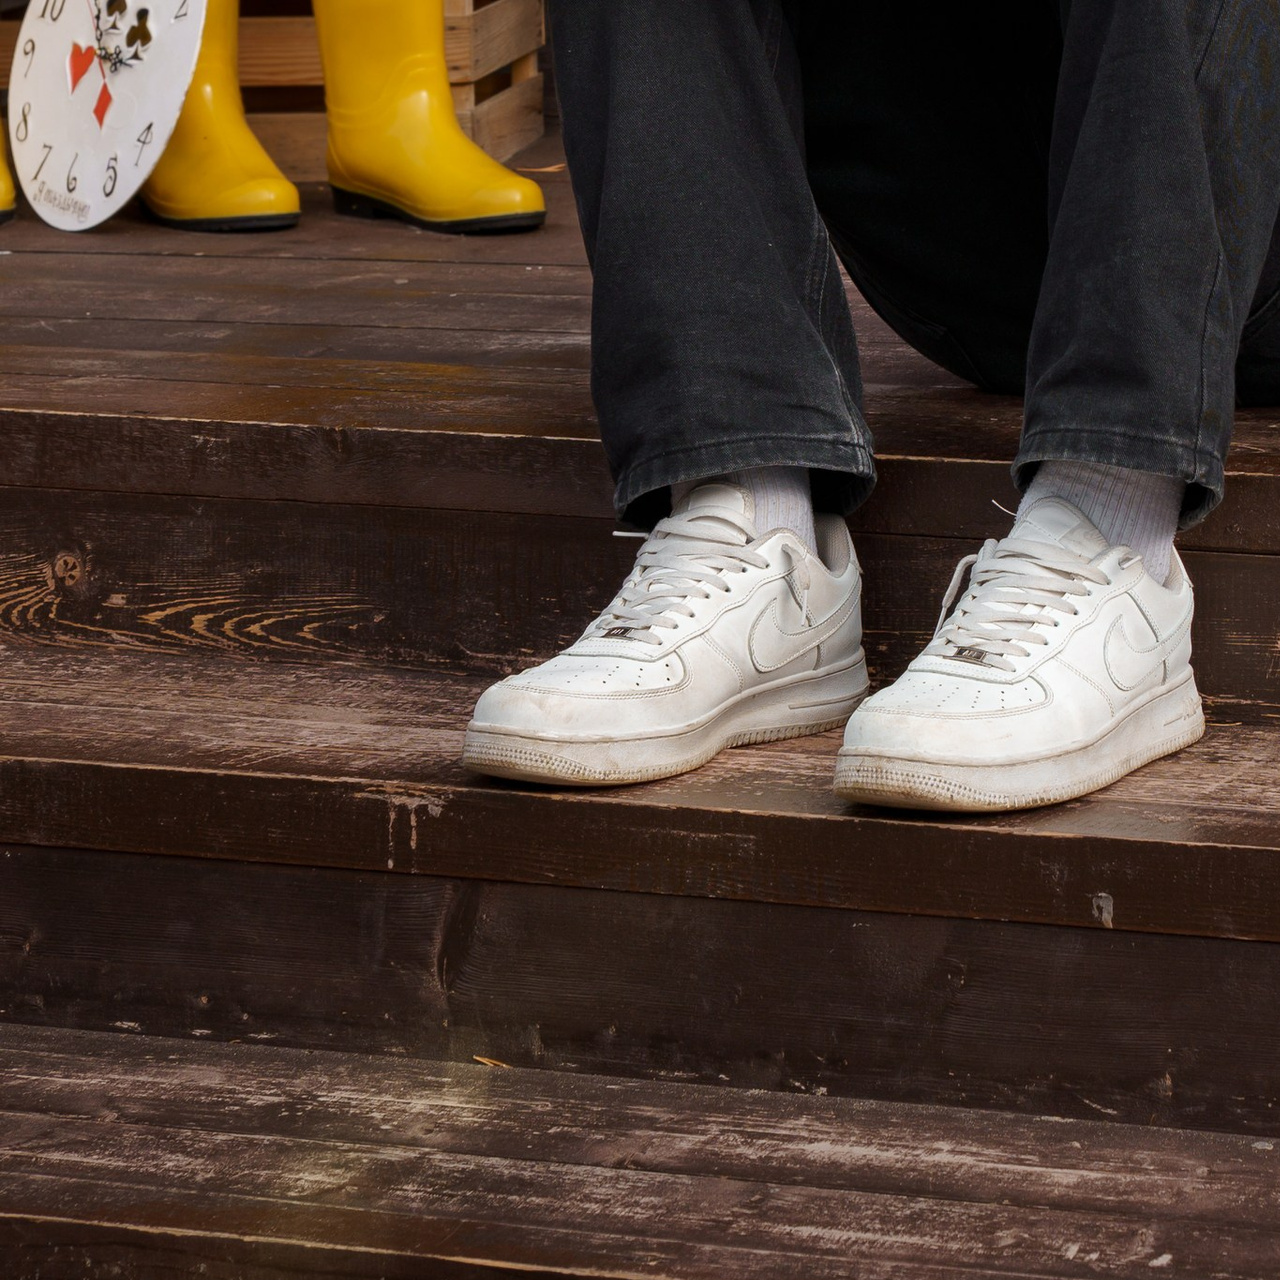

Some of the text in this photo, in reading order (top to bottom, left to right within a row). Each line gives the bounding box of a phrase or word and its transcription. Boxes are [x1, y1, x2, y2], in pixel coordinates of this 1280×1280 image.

[23, 39, 35, 78] 9
[16, 102, 31, 142] 8
[32, 143, 52, 181] 7
[134, 122, 153, 167] 4
[66, 152, 77, 193] 6
[103, 153, 118, 198] 5
